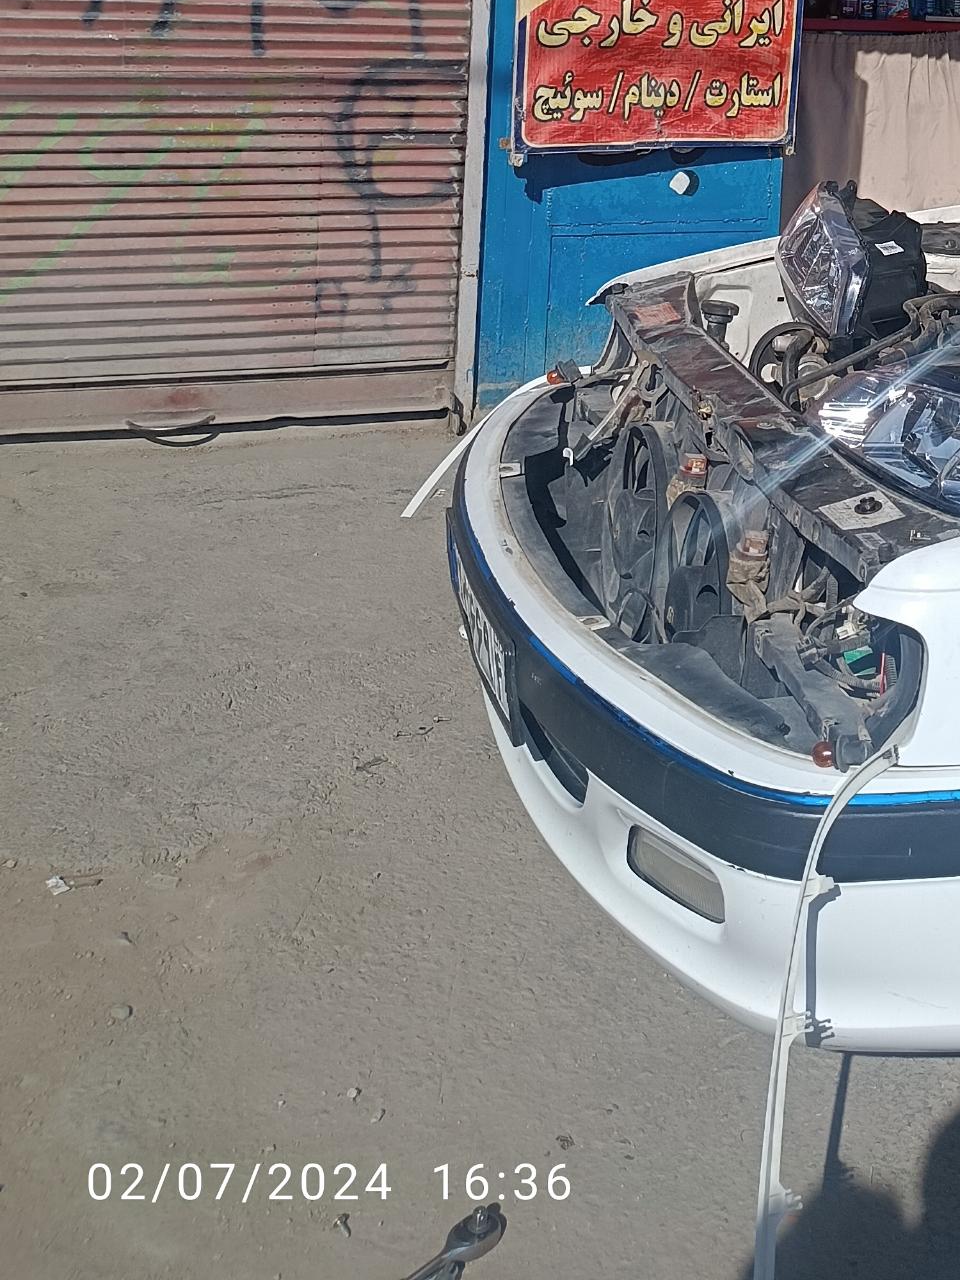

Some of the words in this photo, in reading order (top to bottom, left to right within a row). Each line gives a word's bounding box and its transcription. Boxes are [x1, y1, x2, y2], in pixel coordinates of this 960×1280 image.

[666, 16, 684, 49] و
[532, 71, 604, 122] سوئیچ
[704, 71, 783, 118] استارت
